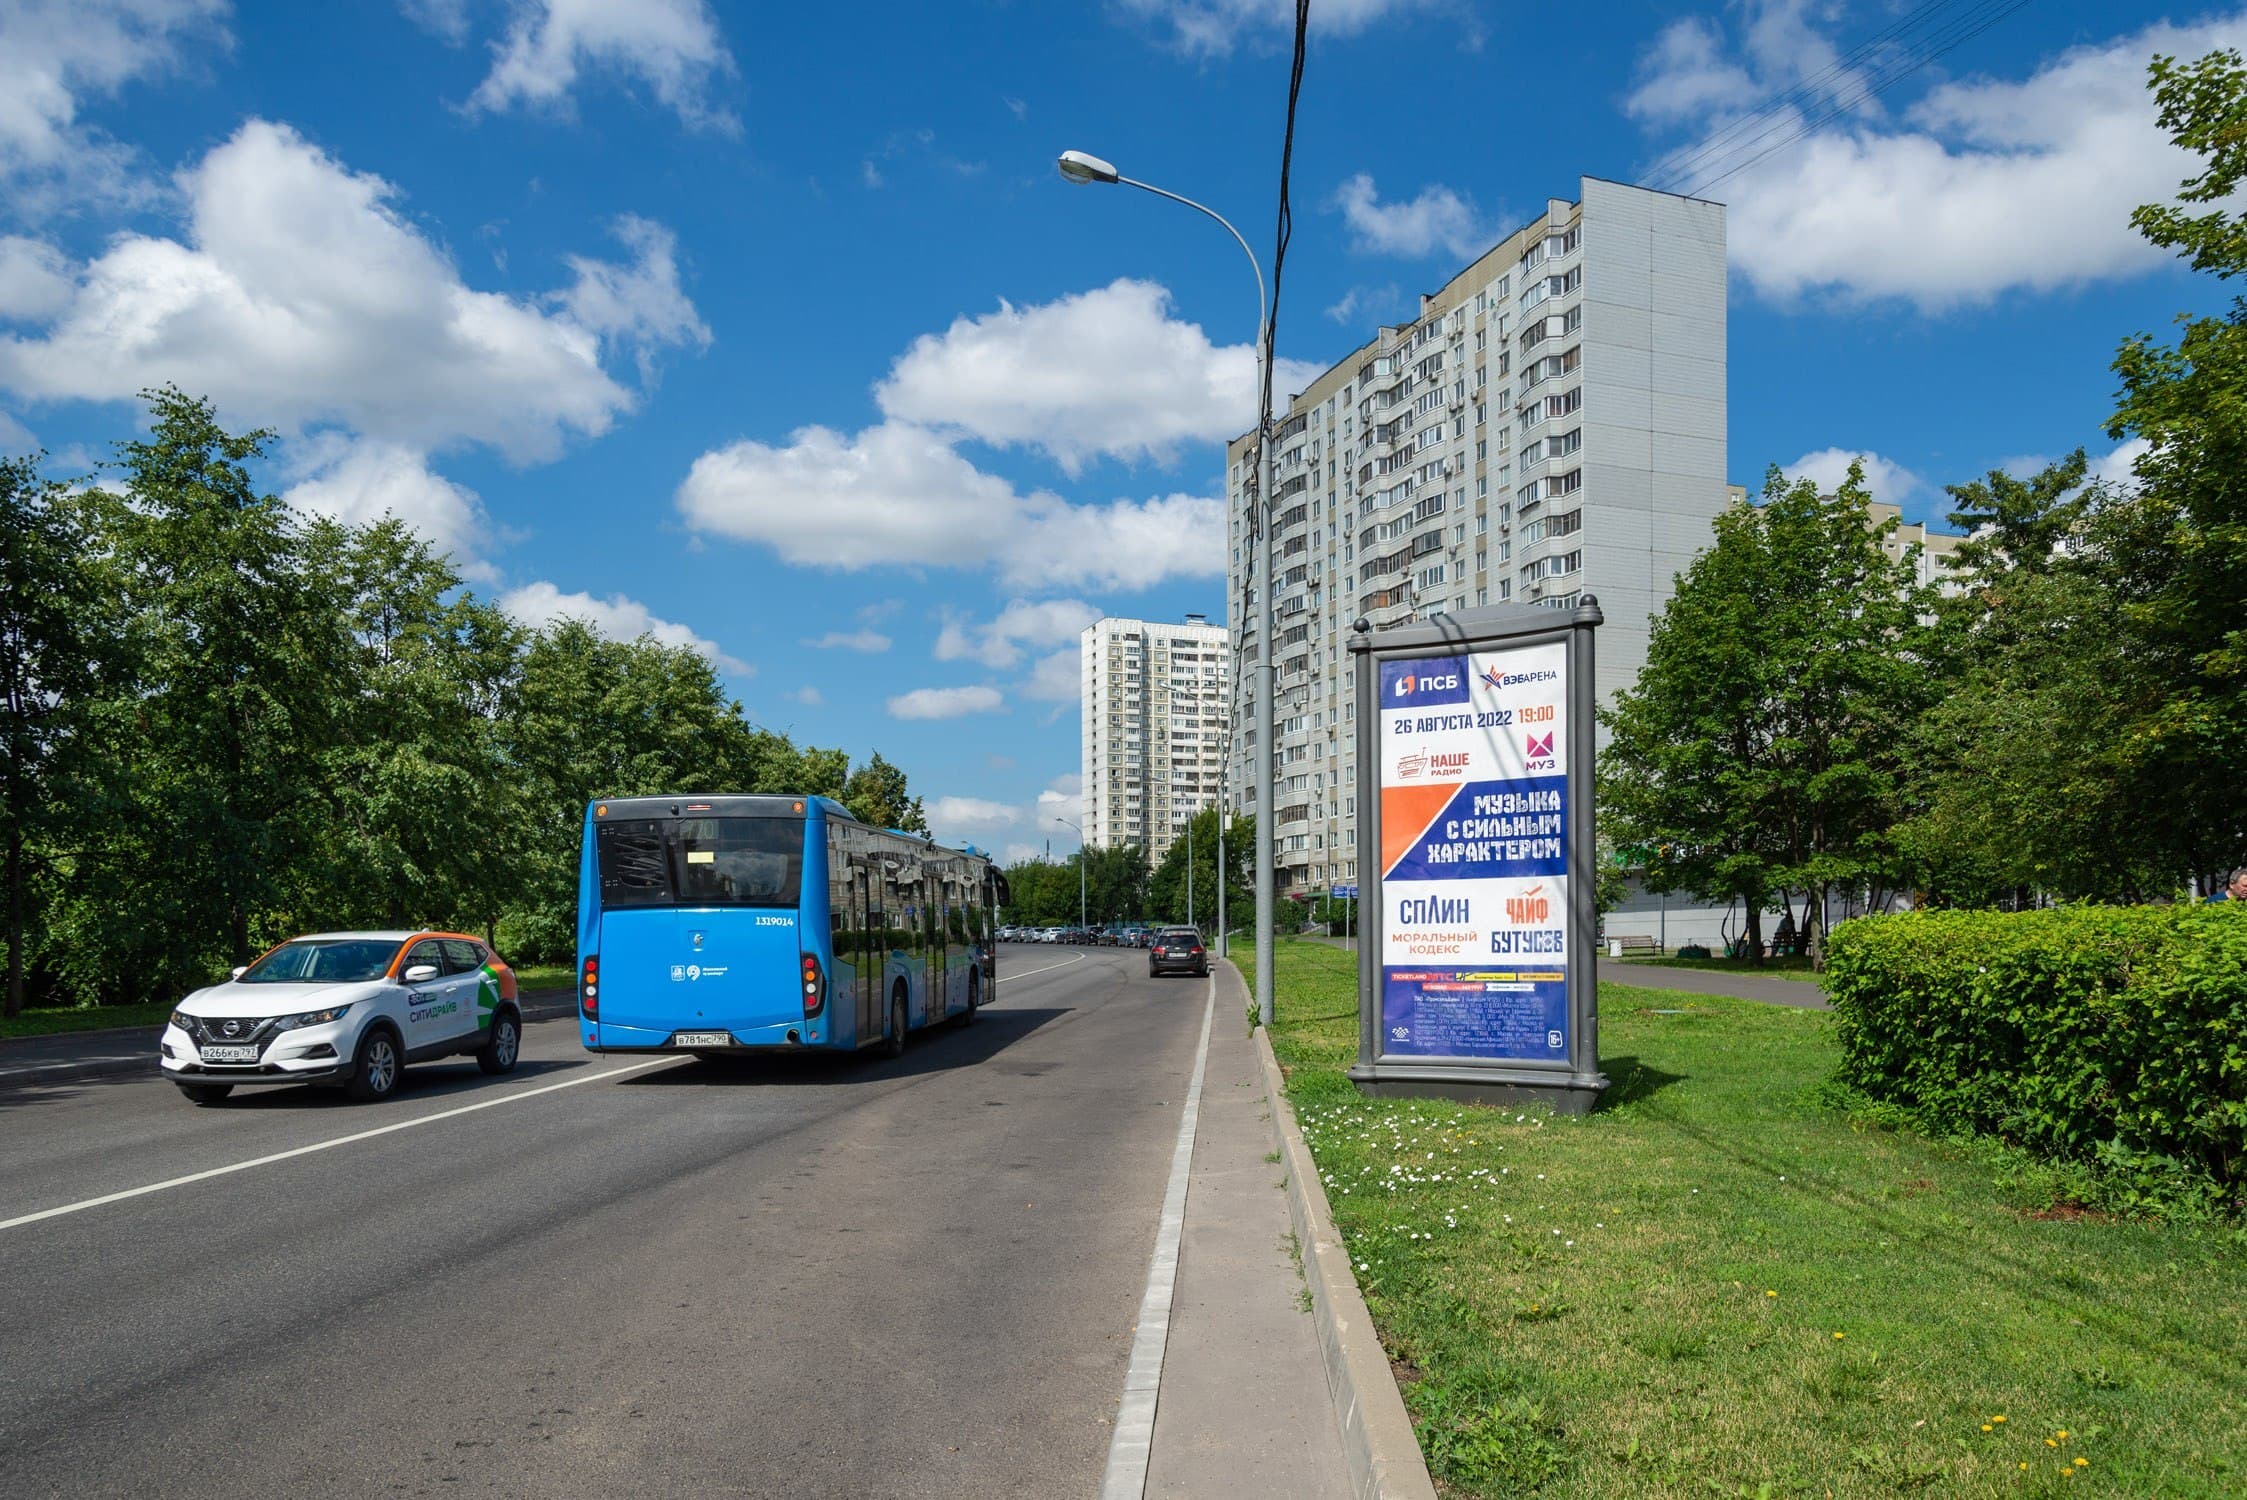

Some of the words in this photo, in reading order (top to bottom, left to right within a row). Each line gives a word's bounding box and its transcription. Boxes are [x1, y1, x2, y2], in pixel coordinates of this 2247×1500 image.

[1420, 675, 1458, 691] ПСБ
[1394, 719, 1412, 735] 26
[1416, 714, 1473, 733] АВГУСТА
[1477, 710, 1512, 728] 2022
[1518, 704, 1554, 723] 19:00
[1430, 752, 1470, 767] НАШЕ
[1525, 759, 1555, 771] МУЗ
[1430, 768, 1462, 777] РАДИО
[1474, 790, 1561, 816] МУЗЫКА
[1446, 820, 1458, 839] С
[1462, 814, 1561, 839] СИЛЬНЫМ
[1427, 837, 1561, 863] ХАРАКТЕРОМ
[1400, 895, 1470, 925] СПЛИН
[1506, 888, 1548, 924] ЧАЙФ
[755, 916, 794, 927] 1319014
[1392, 930, 1478, 943] МОРАЛЬНЫЙ
[1409, 945, 1461, 955] КОДЕКС
[410, 1001, 457, 1023] СИТИДРАЙВ
